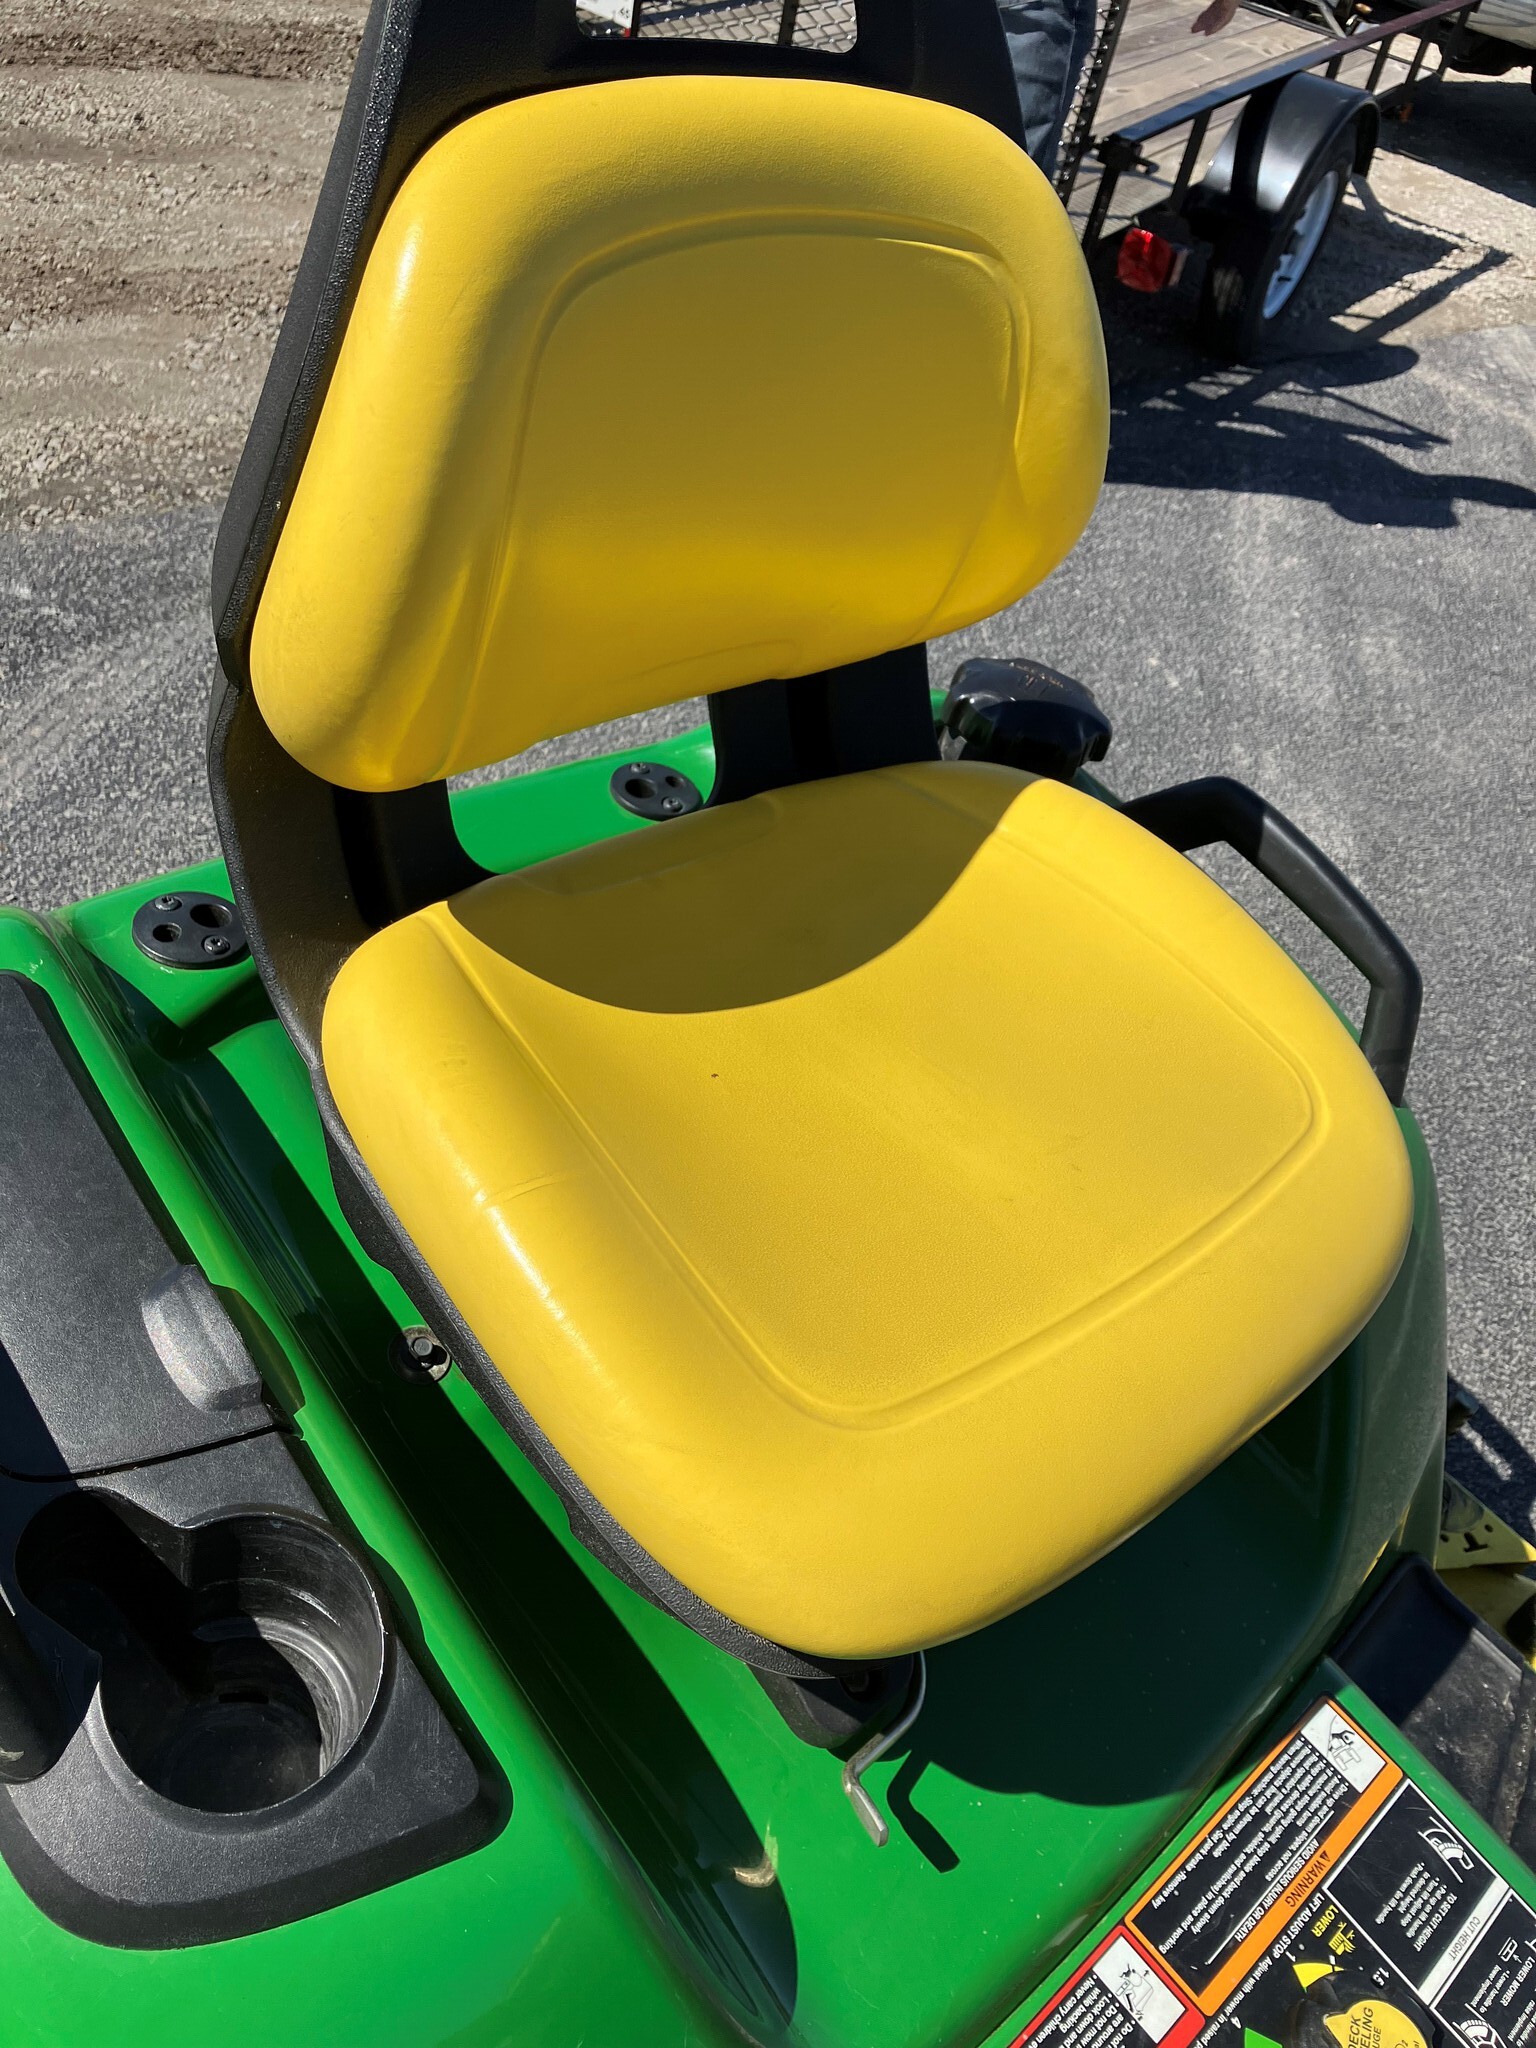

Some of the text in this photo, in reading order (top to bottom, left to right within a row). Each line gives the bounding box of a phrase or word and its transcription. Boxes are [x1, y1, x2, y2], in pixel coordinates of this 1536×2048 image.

[1323, 1775, 1340, 1795] Avoid
[1331, 1782, 1348, 1802] Drive
[1248, 1804, 1259, 1817] be
[1316, 1803, 1330, 1820] and
[1324, 1795, 1335, 1808] up
[1232, 1812, 1253, 1836] thrown
[1295, 1809, 1312, 1828] turns
[1304, 1814, 1321, 1834] down
[1198, 1837, 1215, 1857] park
[1224, 1830, 1237, 1844] by
[1211, 1838, 1230, 1860] blade
[1233, 1851, 1248, 1868] and
[1255, 1840, 1271, 1859] stop
[1280, 1849, 1292, 1864] not
[1184, 1851, 1203, 1874] brake
[1242, 1853, 1261, 1875] blade
[1264, 1858, 1284, 1882] across
[1209, 1862, 1238, 1895] switches)
[1233, 1869, 1247, 1886] and
[1284, 1857, 1326, 1909] WARNING
[1205, 1890, 1215, 1902] in
[1221, 1880, 1238, 1900] back
[1233, 1838, 1319, 1943] AVOID SERIOUS INJURY OR DEATH
[1428, 1894, 1438, 1907] up
[1150, 1894, 1166, 1910] key
[1190, 1895, 1209, 1918] place
[1207, 1894, 1226, 1916] down
[1307, 1891, 1325, 1913] LIFT
[1423, 1902, 1432, 1914] on
[1180, 1913, 1195, 1931] and
[1189, 1911, 1212, 1936] slowly
[1285, 1906, 1313, 1940] ADJUST
[1310, 1903, 1339, 1939] LOWER
[1399, 1911, 1413, 1928] stop
[1405, 1917, 1423, 1940] handle
[1412, 1891, 1457, 1952] TO SET CUT HEIGHT
[1157, 1925, 1185, 1956] working
[1269, 1933, 1291, 1960] STOP
[1447, 1914, 1481, 1961] CUT HEIGHT
[1284, 1948, 1297, 1963] 1
[1251, 1954, 1274, 1981] Adjust
[1371, 1964, 1391, 1987] 1.5
[1074, 1976, 1095, 2001] Never
[1241, 1975, 1257, 1995] with
[1499, 1955, 1535, 2007] LOWER MOWER
[1223, 1989, 1245, 2017] mower
[1478, 1971, 1509, 2015] Lower handle to
[1057, 1995, 1078, 2017] carry
[1058, 1986, 1101, 2035] while backing
[1524, 1999, 1536, 2016] raise
[1035, 2012, 1063, 2045] children
[1062, 1994, 1110, 2048] Look down and
[1079, 2003, 1118, 2047] Do not mow
[1111, 2012, 1124, 2028] are
[1216, 2013, 1228, 2026] in
[1229, 2013, 1244, 2030] 4
[1110, 2021, 1134, 2048] Do not
[1200, 2020, 1222, 2047] raised
[1519, 2021, 1535, 2042] handle
[1516, 2038, 1524, 2048] to
